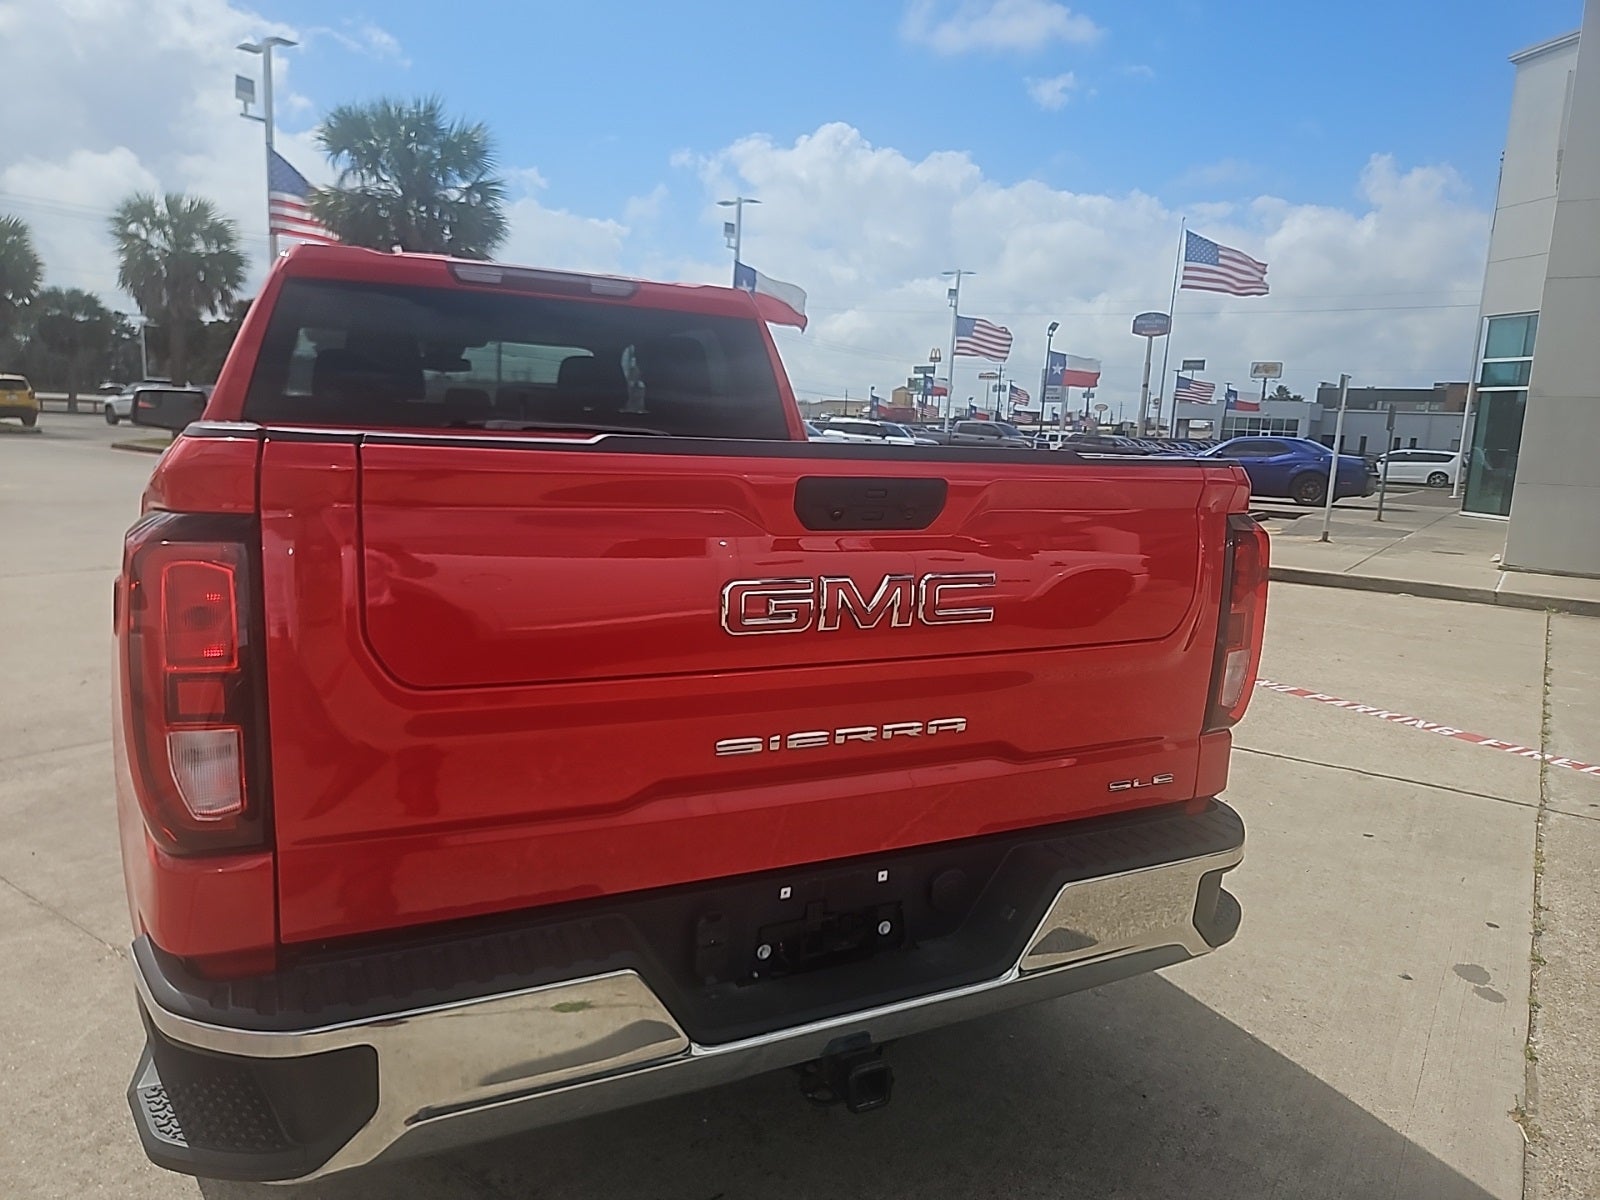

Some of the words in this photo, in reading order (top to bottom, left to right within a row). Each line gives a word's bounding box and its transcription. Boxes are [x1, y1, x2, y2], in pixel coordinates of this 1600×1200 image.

[721, 571, 996, 636] GMC
[1303, 693, 1464, 736] PARKING
[715, 717, 967, 757] SIERRA
[1107, 773, 1175, 792] SLE
